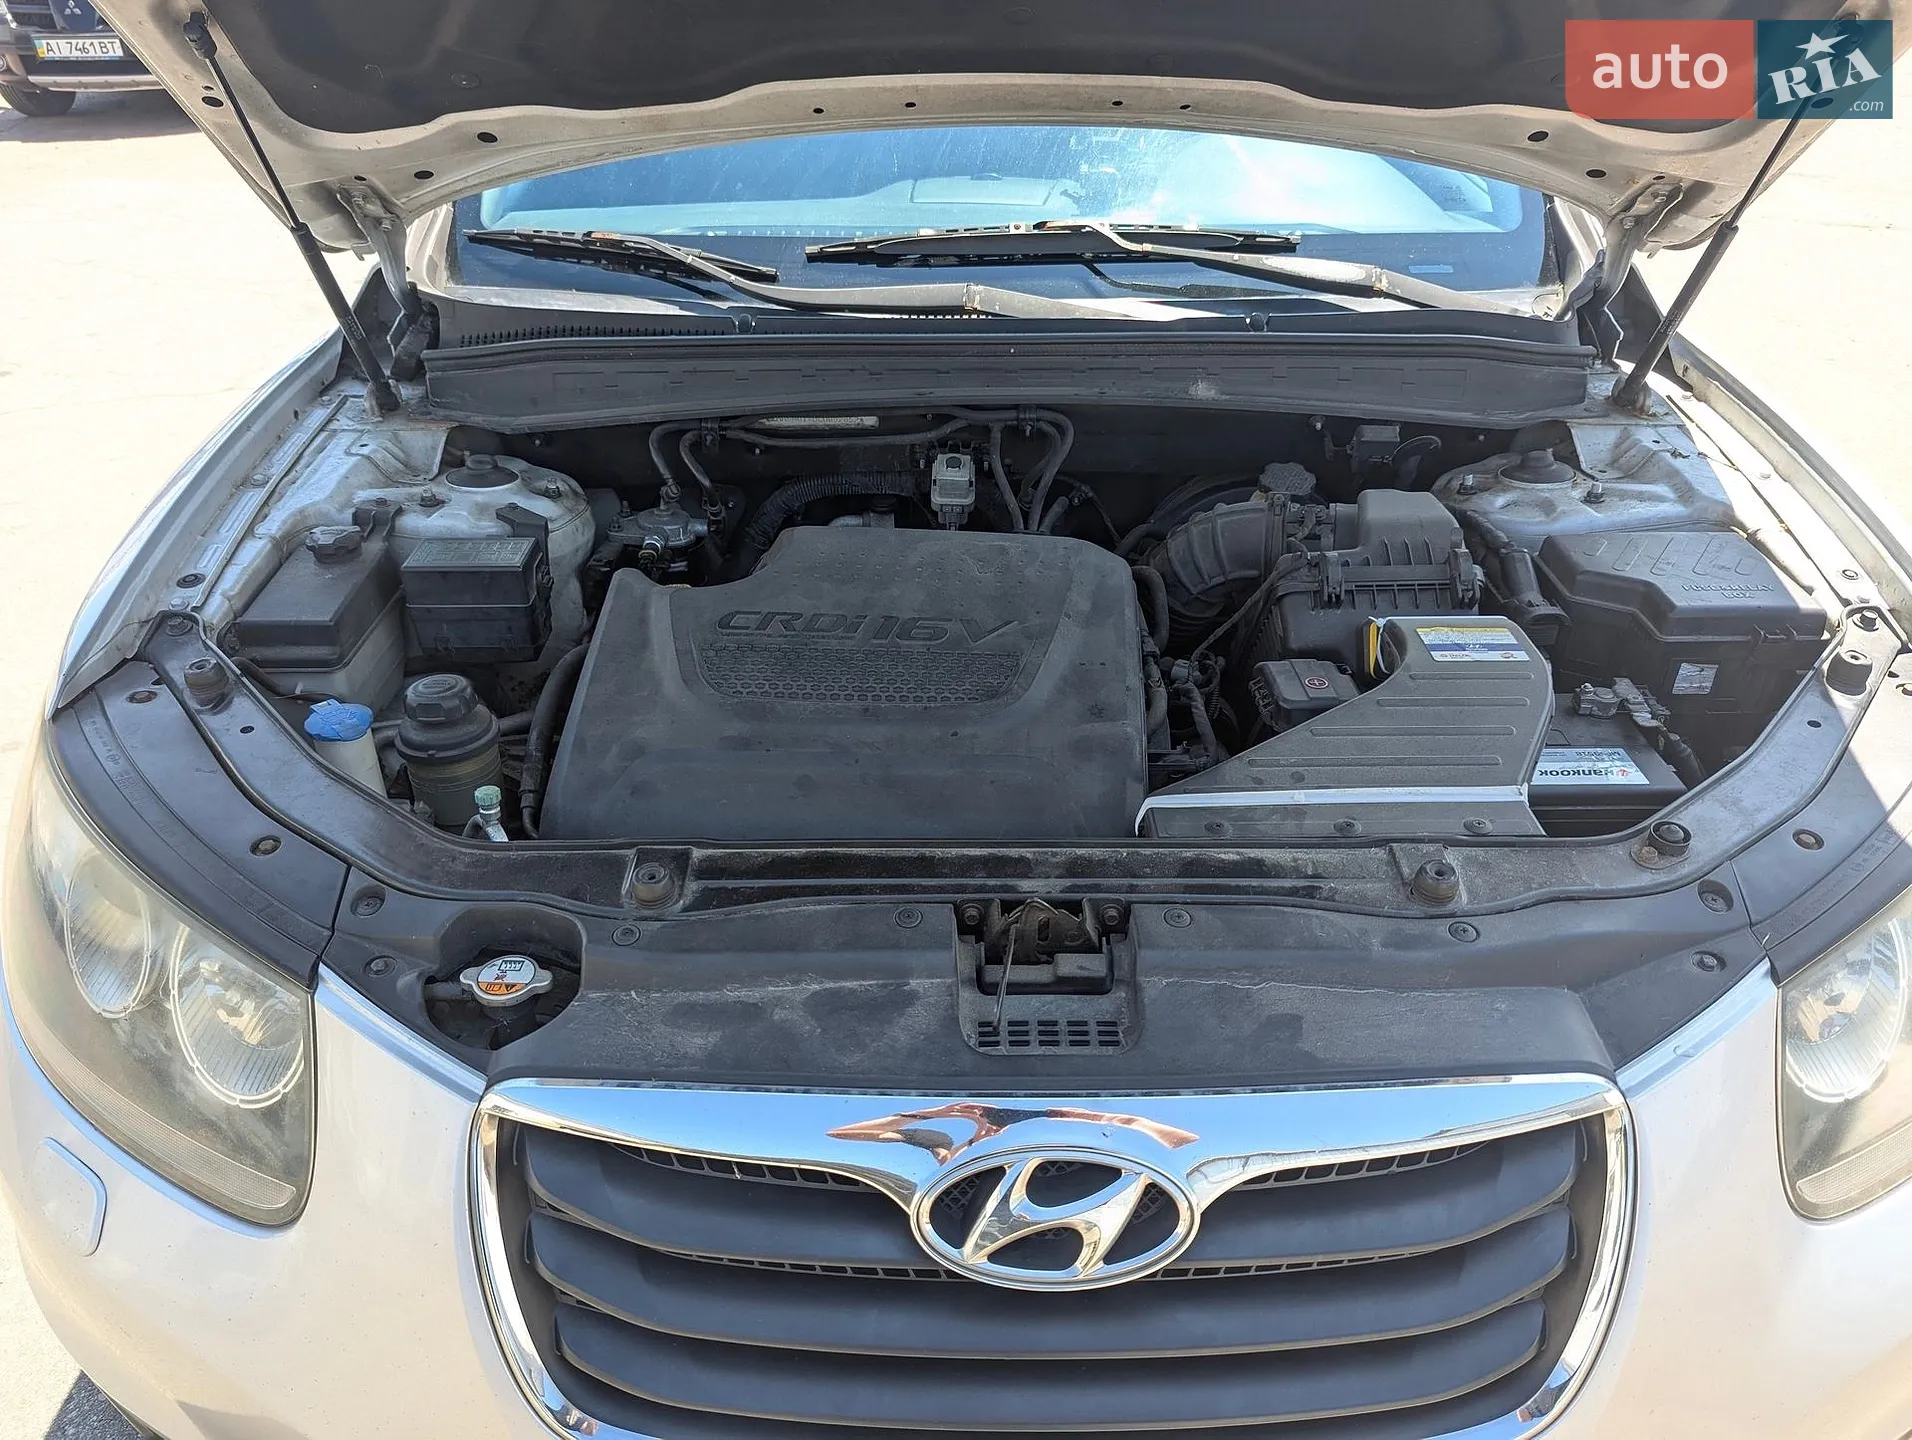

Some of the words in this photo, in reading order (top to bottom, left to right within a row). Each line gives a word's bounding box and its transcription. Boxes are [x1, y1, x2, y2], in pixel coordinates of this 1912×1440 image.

[46, 41, 62, 55] AI
[65, 41, 98, 55] 7461
[99, 41, 117, 55] BT
